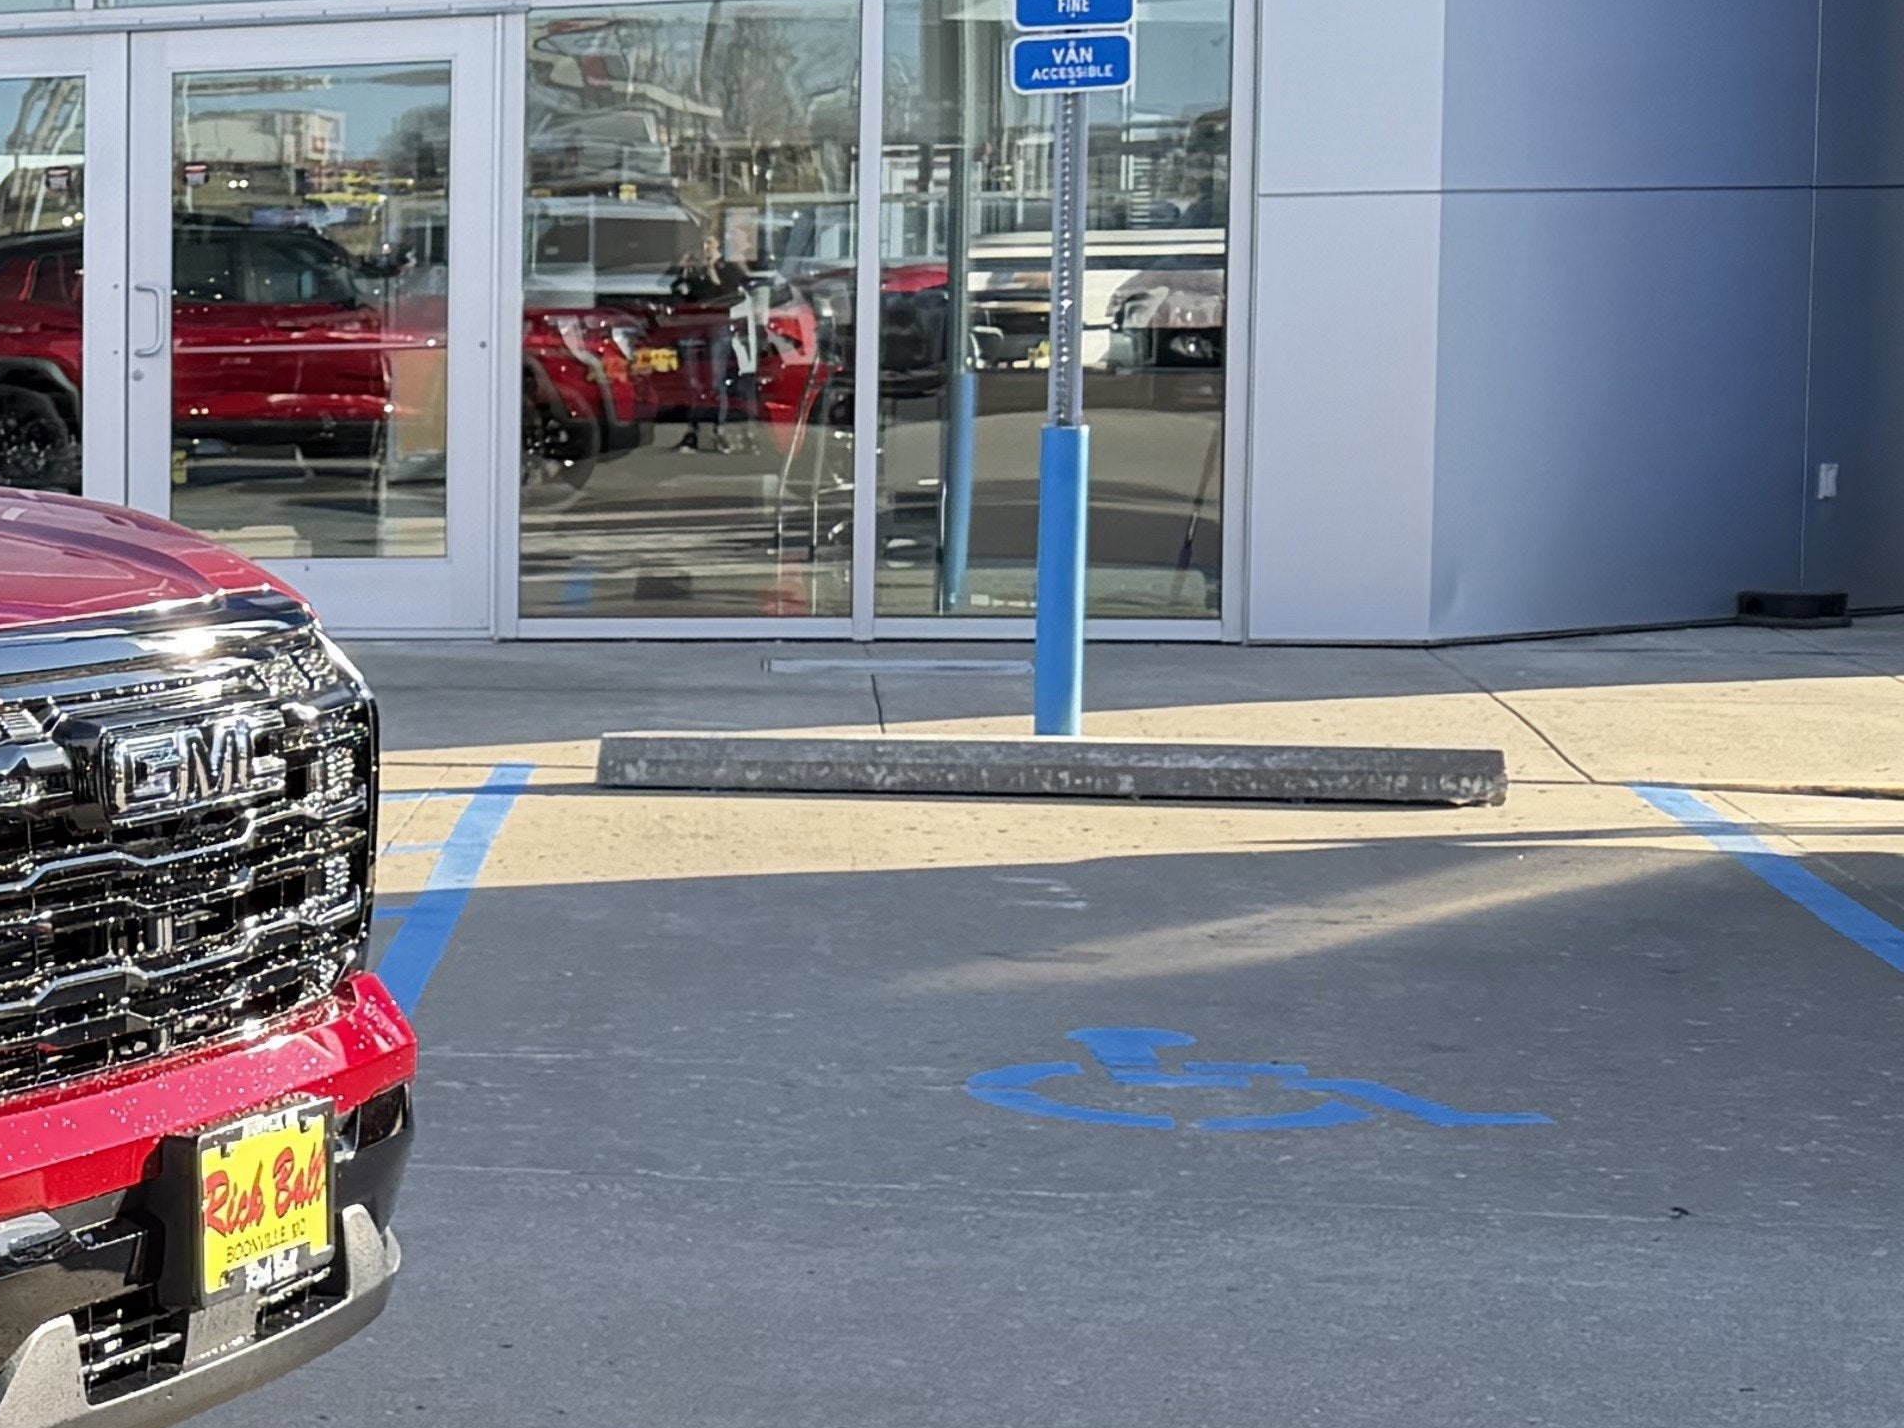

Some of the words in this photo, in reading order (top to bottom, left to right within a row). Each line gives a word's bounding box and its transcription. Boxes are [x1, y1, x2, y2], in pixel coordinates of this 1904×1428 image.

[1031, 65, 1113, 80] ACCESSIBLE
[1052, 46, 1093, 64] VAN
[113, 714, 287, 813] GMC
[202, 1160, 266, 1238] Rick
[272, 1142, 328, 1219] Ball
